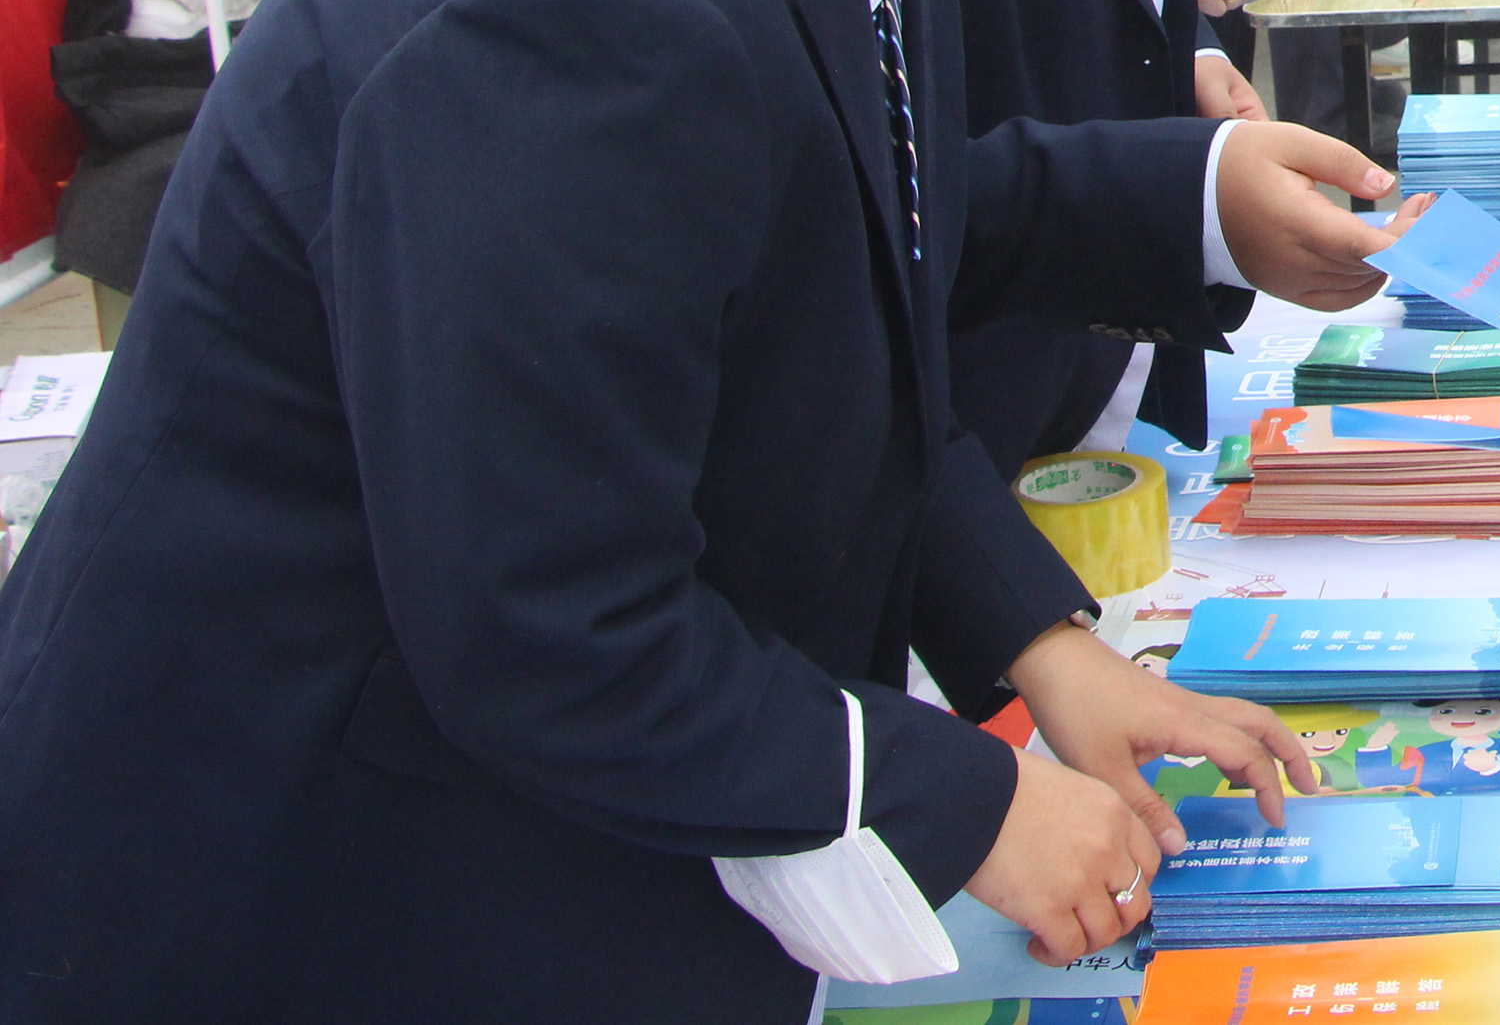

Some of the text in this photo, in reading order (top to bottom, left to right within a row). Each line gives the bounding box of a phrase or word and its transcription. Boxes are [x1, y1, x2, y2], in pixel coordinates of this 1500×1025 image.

[1291, 978, 1444, 999] 政策解答
[1287, 999, 1442, 1016] 工伤保险
